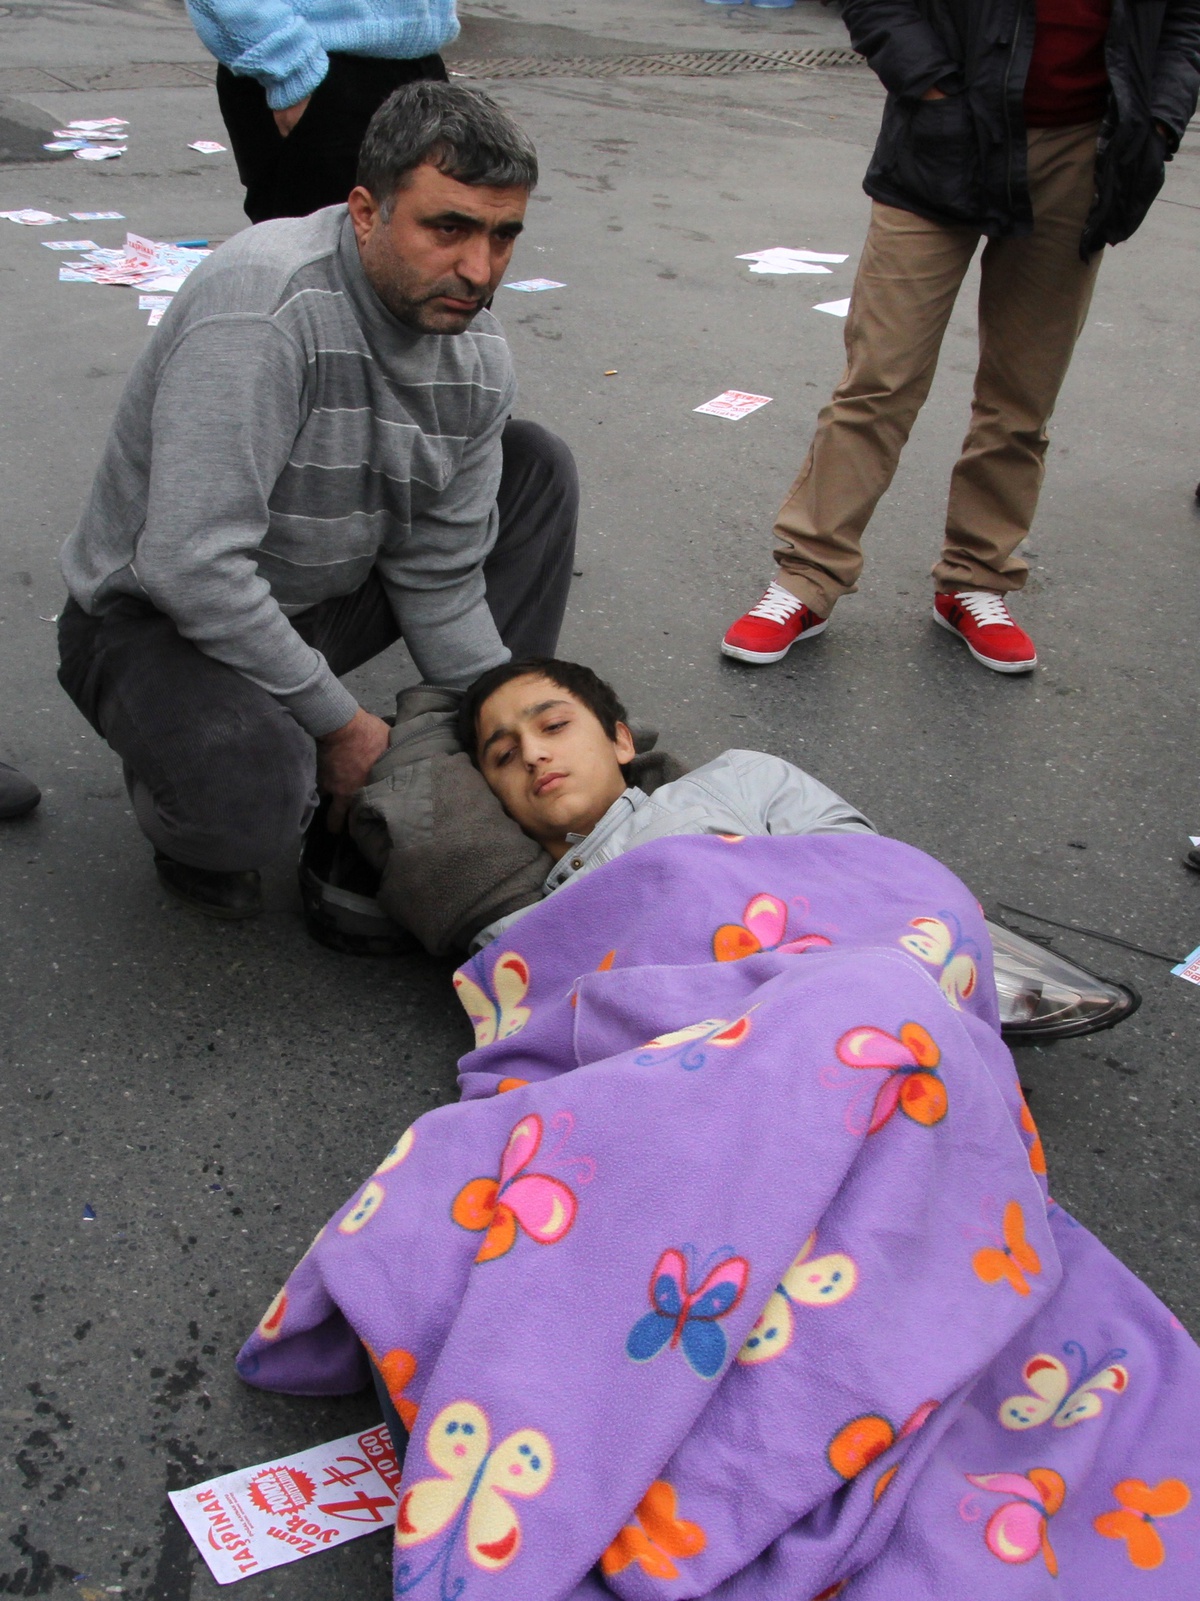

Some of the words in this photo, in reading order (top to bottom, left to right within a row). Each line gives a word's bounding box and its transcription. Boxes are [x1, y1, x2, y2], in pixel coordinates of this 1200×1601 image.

[361, 1435, 384, 1456] 60
[255, 1472, 294, 1514] POMPA
[196, 1488, 259, 1573] TAŞPINAR
